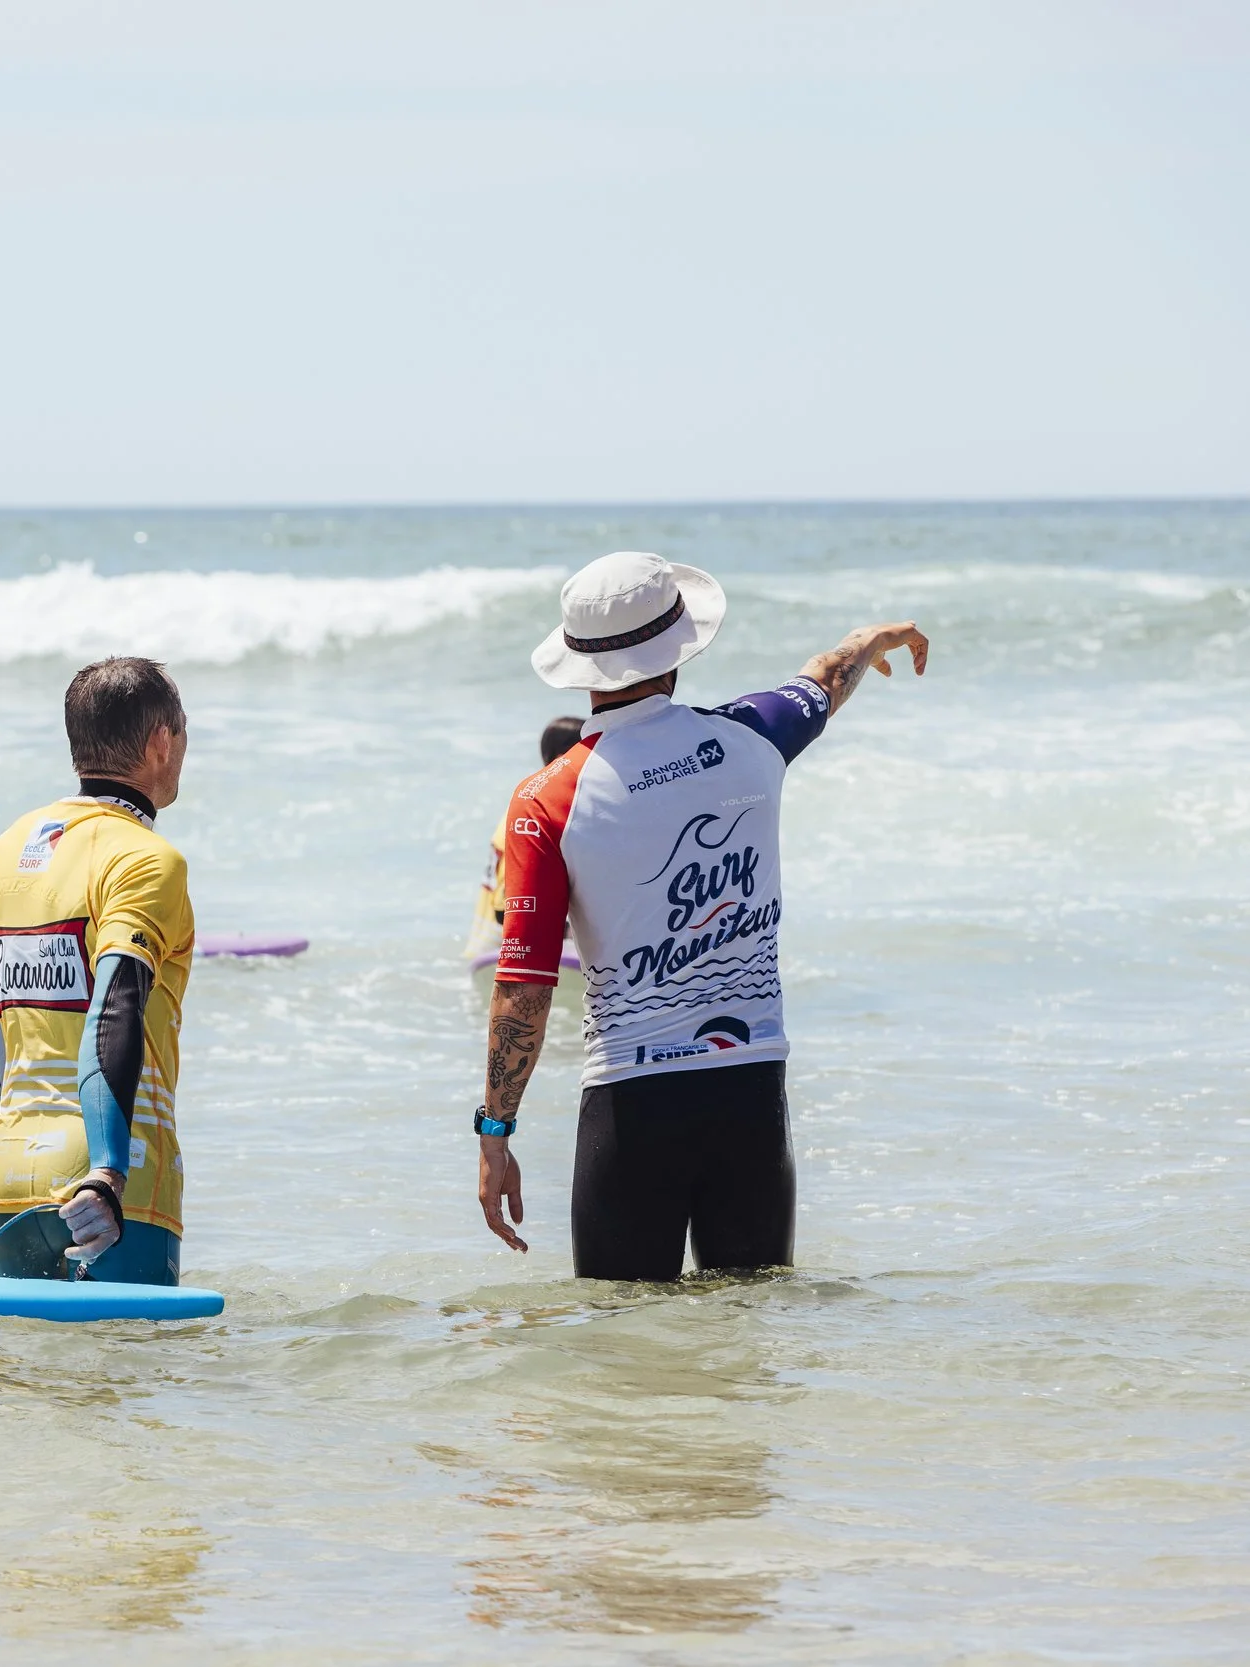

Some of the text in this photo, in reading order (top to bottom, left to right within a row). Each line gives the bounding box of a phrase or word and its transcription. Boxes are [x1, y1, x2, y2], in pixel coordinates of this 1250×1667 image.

[628, 764, 700, 793] POPULAIRE
[642, 755, 696, 779] BANQUE
[720, 793, 766, 807] VOLCOM
[18, 859, 42, 869] SURF
[667, 846, 760, 933] Surf
[39, 937, 76, 966] Surf Club
[622, 898, 781, 988] Moniteur
